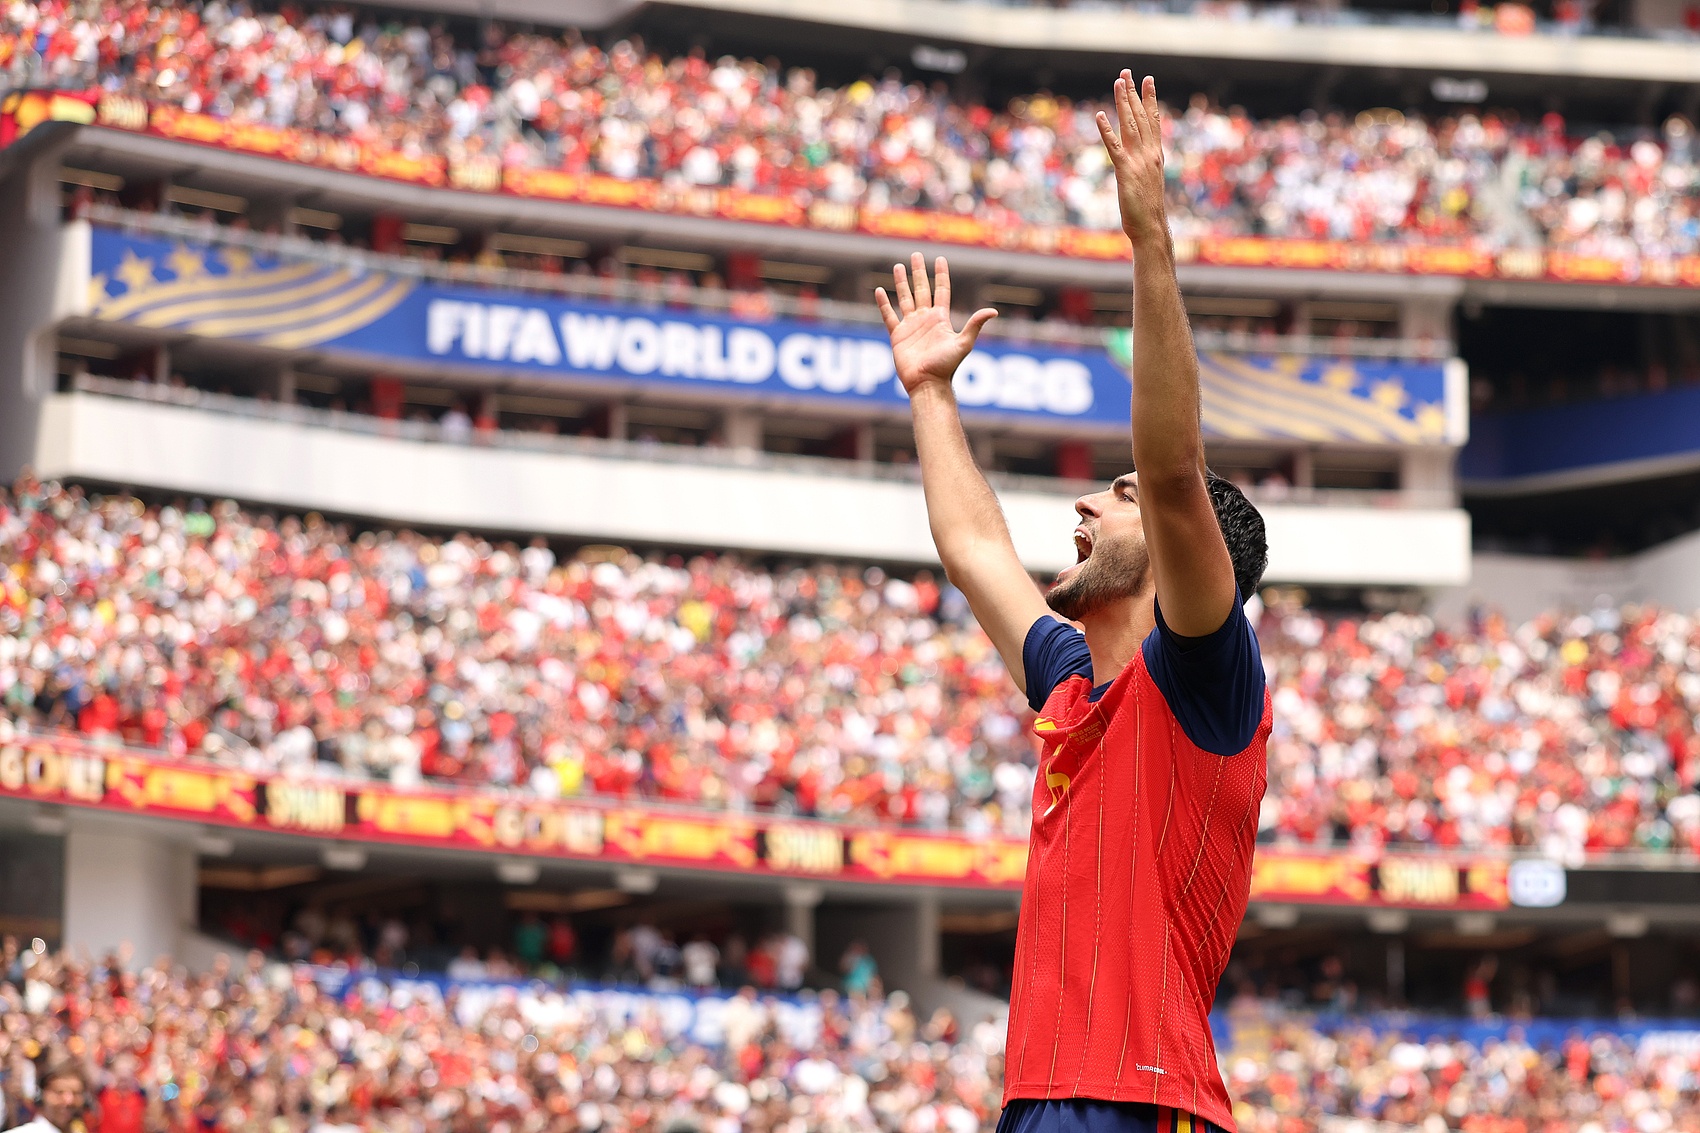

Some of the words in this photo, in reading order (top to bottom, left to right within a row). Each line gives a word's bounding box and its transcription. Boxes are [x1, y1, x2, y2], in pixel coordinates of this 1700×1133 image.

[427, 299, 560, 365] FIFA
[559, 311, 776, 384] WORLD
[778, 332, 897, 395] CUP
[895, 350, 1094, 415] 026
